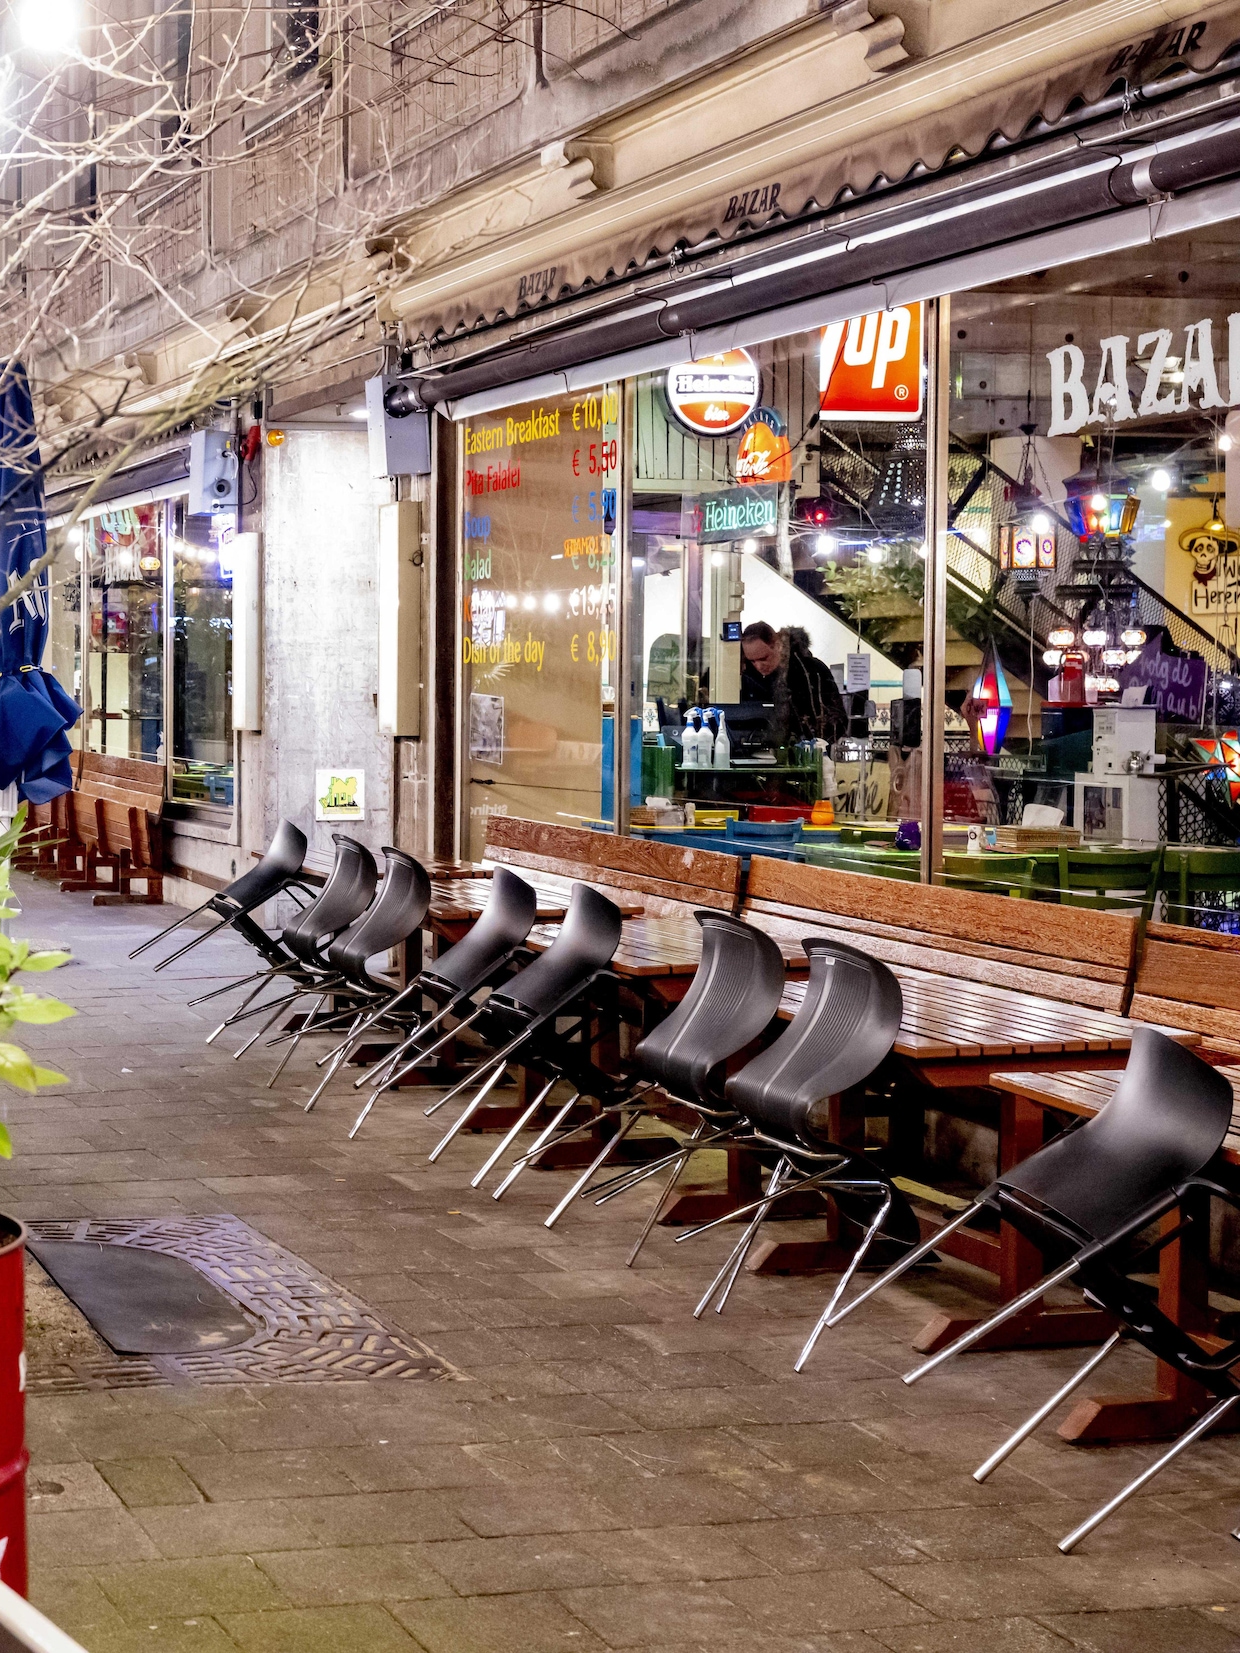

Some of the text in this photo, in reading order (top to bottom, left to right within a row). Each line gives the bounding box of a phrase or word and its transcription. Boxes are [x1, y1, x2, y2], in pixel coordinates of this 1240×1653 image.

[722, 182, 781, 223] BAZAR
[519, 266, 558, 300] BAZAR
[465, 425, 503, 456] Eastern
[506, 407, 560, 446] Breakfast
[465, 469, 484, 496] Pita
[487, 458, 521, 492] Falafel
[589, 439, 617, 476] 5,50
[465, 512, 491, 544] Soup
[588, 488, 617, 523] 5,90
[704, 499, 776, 532] Heineken
[464, 548, 491, 581] Salad
[463, 636, 489, 664] Dish
[504, 633, 521, 663] the
[524, 632, 545, 672] day
[587, 630, 616, 666] 8,90
[1172, 658, 1192, 687] de
